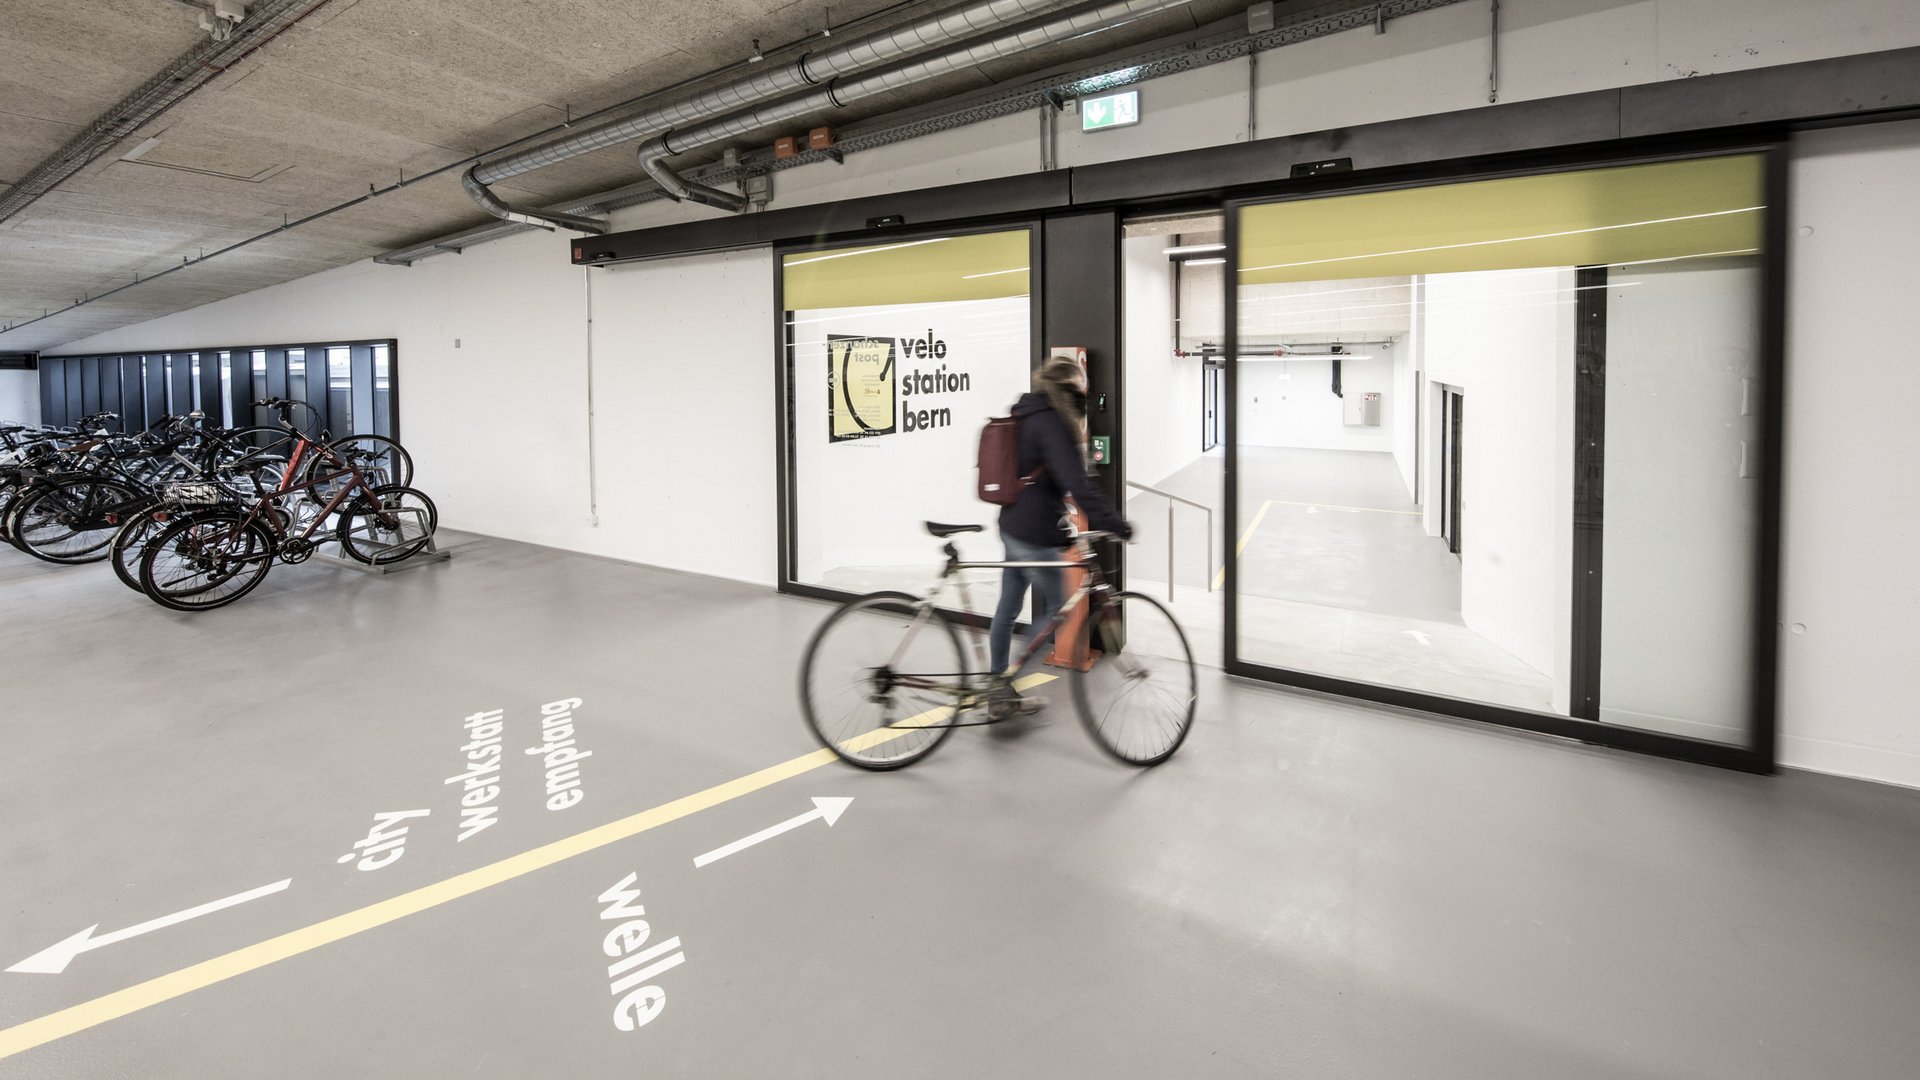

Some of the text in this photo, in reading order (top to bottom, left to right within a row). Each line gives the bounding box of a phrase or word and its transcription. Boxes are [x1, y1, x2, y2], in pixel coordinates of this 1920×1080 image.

[900, 328, 947, 360] velo
[902, 363, 970, 396] station
[902, 400, 951, 433] bern
[444, 708, 504, 843] werkstatt
[525, 697, 592, 811] empfang
[337, 808, 431, 871] city
[598, 871, 686, 1032] welle
